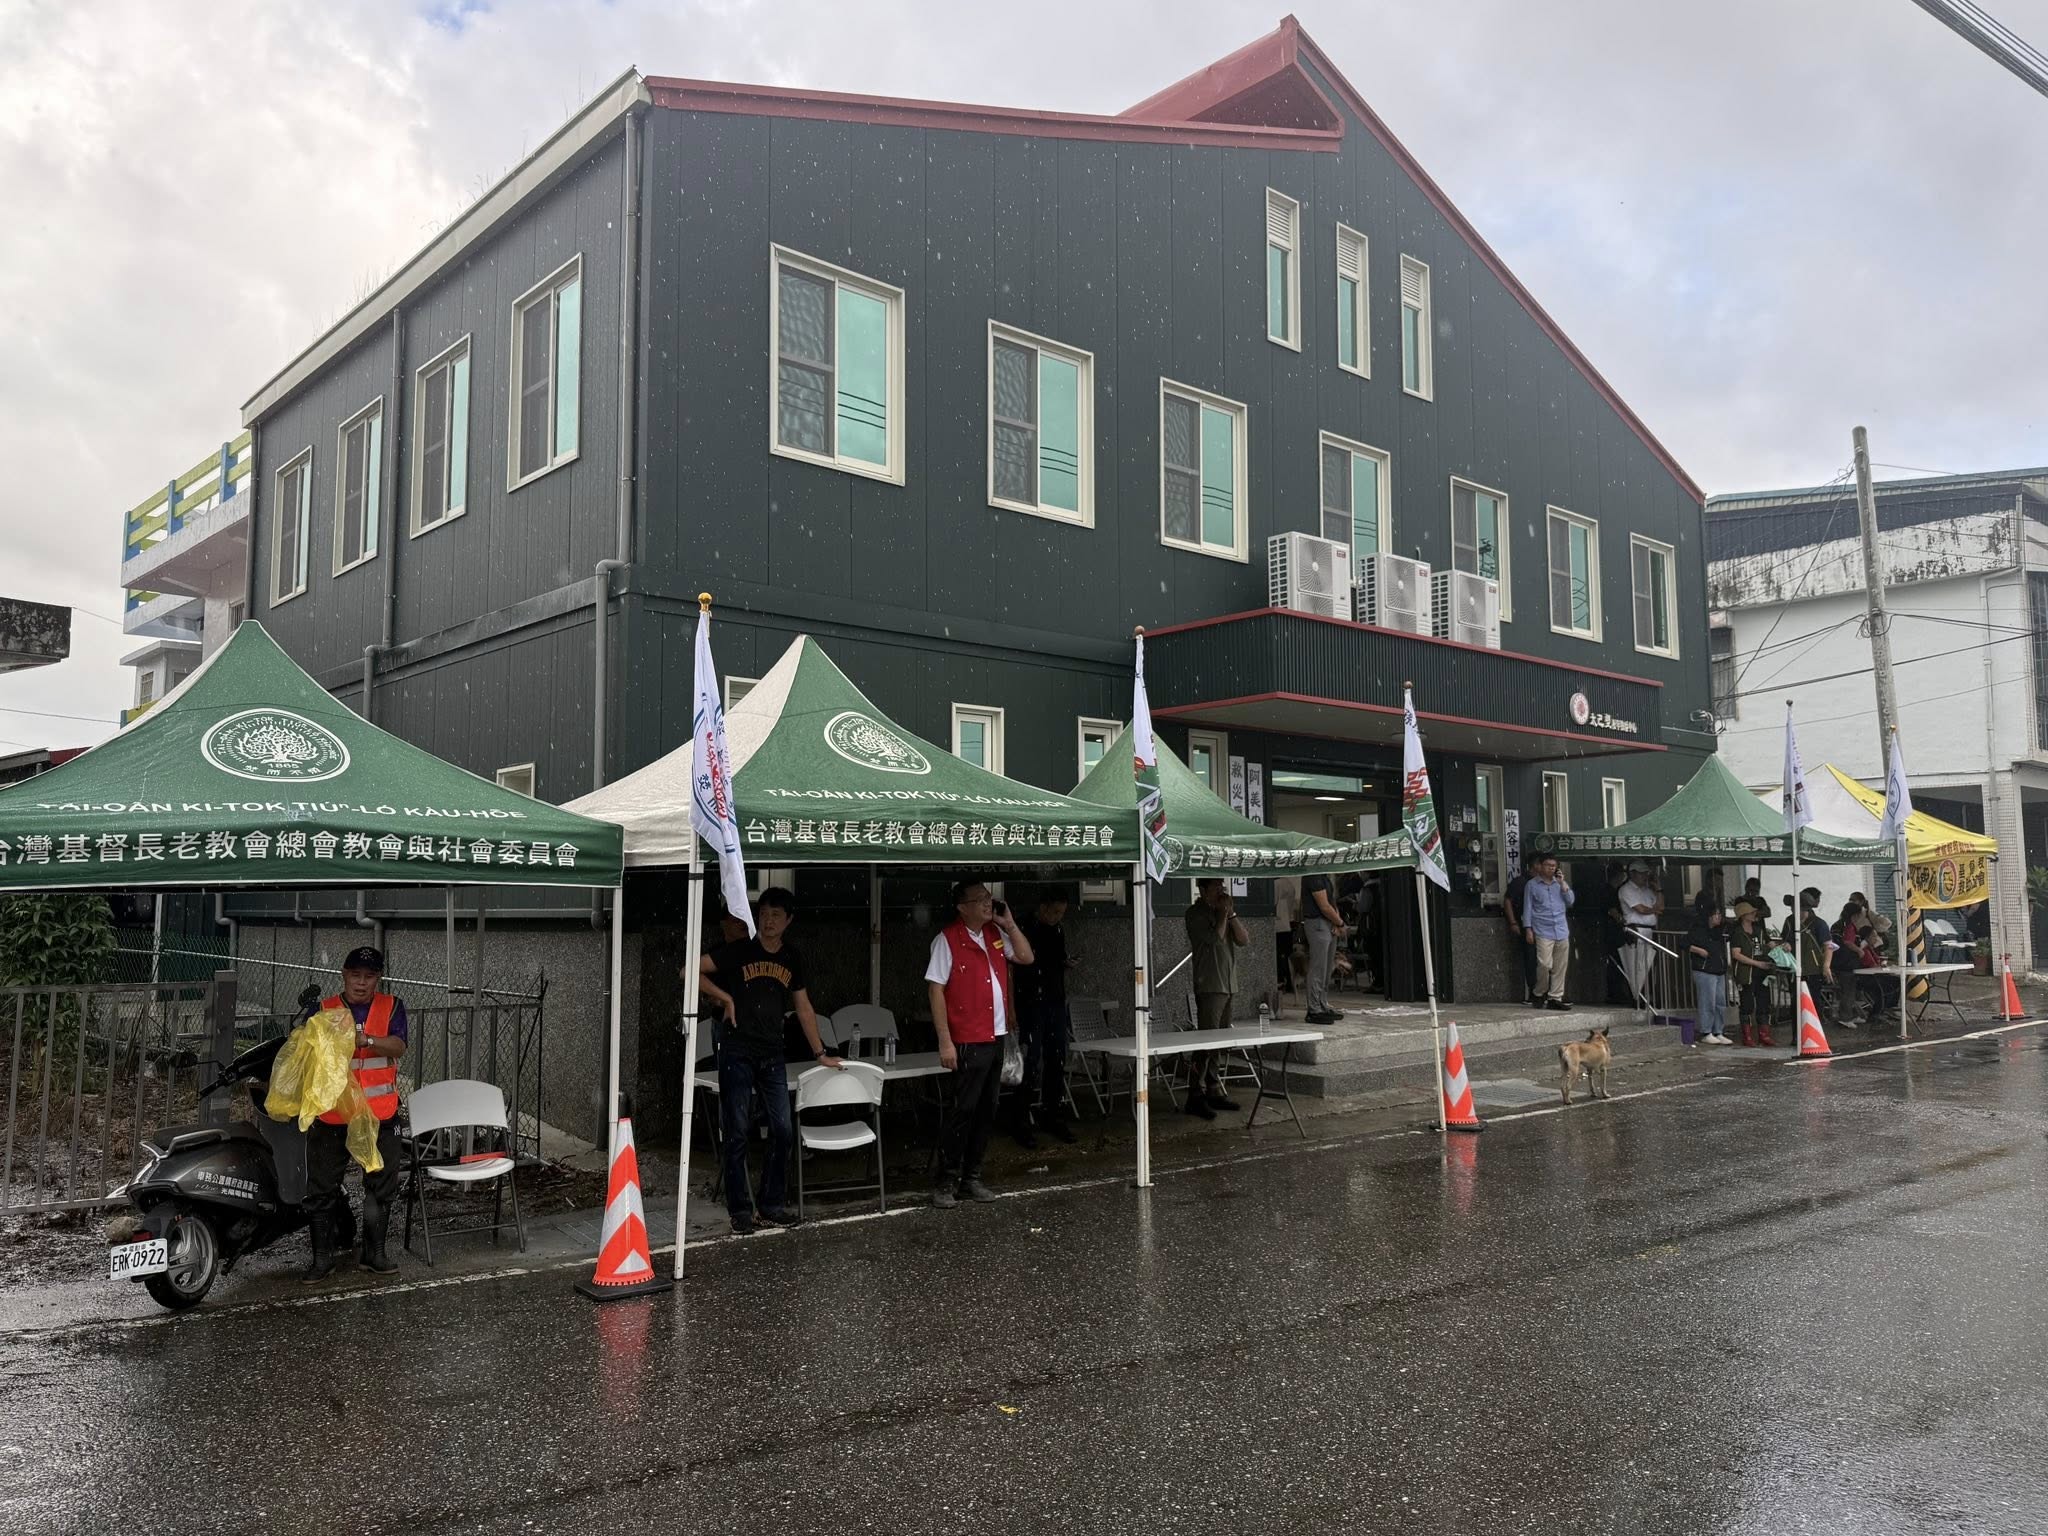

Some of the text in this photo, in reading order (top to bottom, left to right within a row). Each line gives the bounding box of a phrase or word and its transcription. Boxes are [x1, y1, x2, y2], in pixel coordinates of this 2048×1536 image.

[182, 802, 286, 812] KI-TOK
[854, 790, 926, 800] KI-TOK
[744, 817, 1115, 848] 台灣基督長老教會總會教會與社會委員會
[1505, 810, 1521, 880] 收容中心
[112, 1247, 165, 1273] ERK-0922
